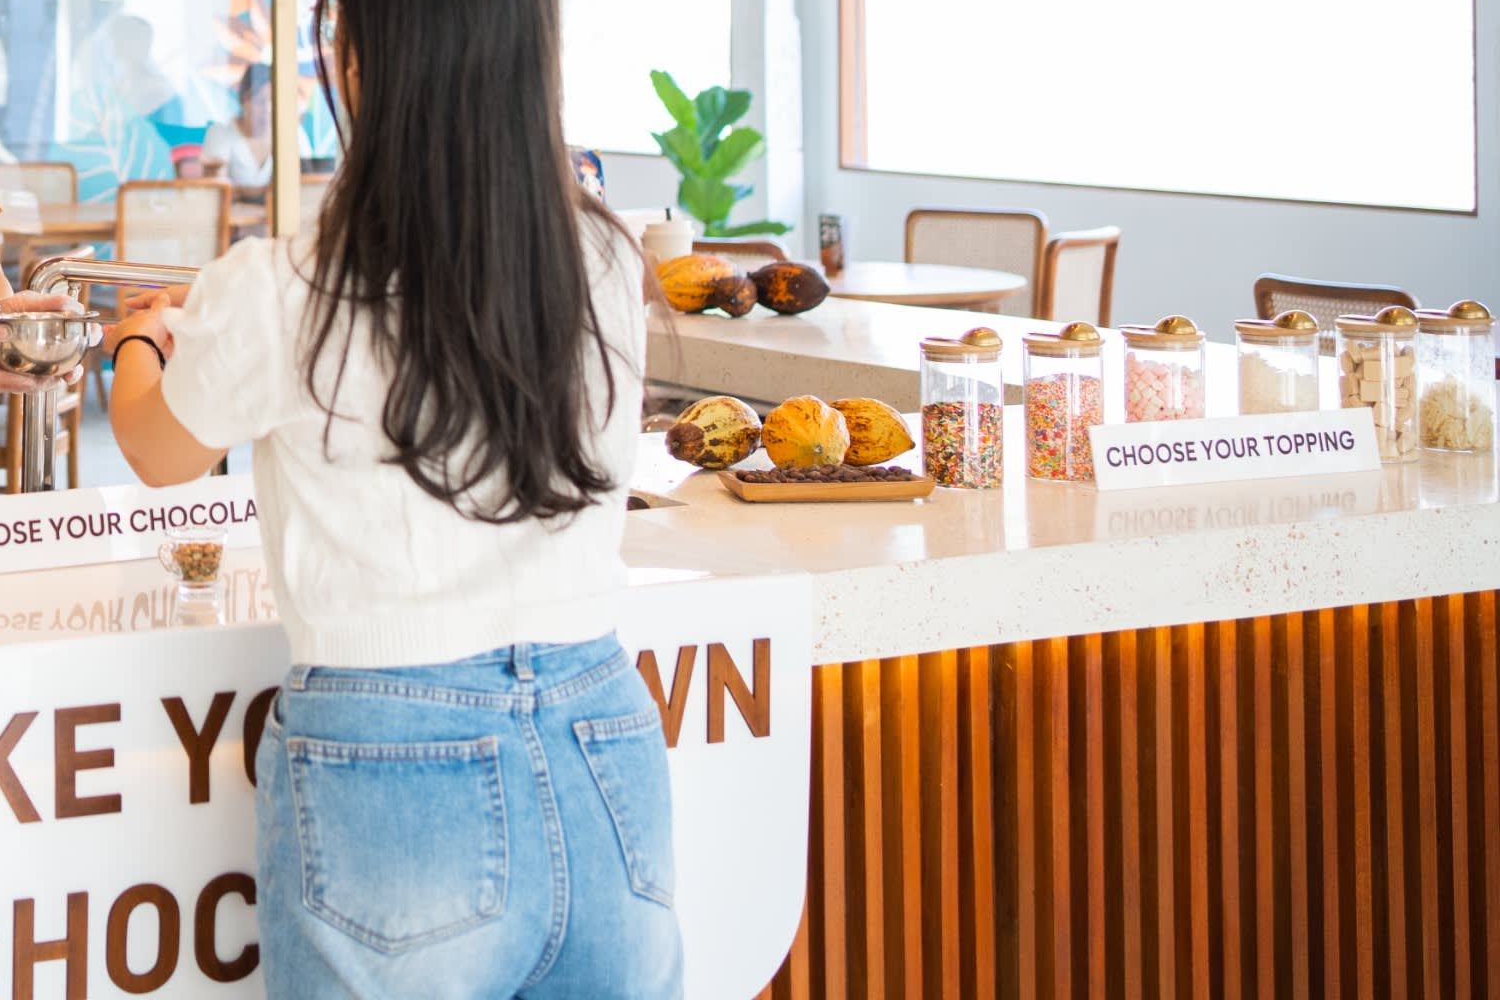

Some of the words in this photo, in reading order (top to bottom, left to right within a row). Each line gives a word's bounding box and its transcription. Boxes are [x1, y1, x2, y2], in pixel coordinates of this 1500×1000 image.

[1106, 441, 1197, 468] CHOOSE
[1200, 437, 1262, 461] YOUR
[1263, 430, 1356, 457] TOPPING
[48, 512, 123, 541] YOUR
